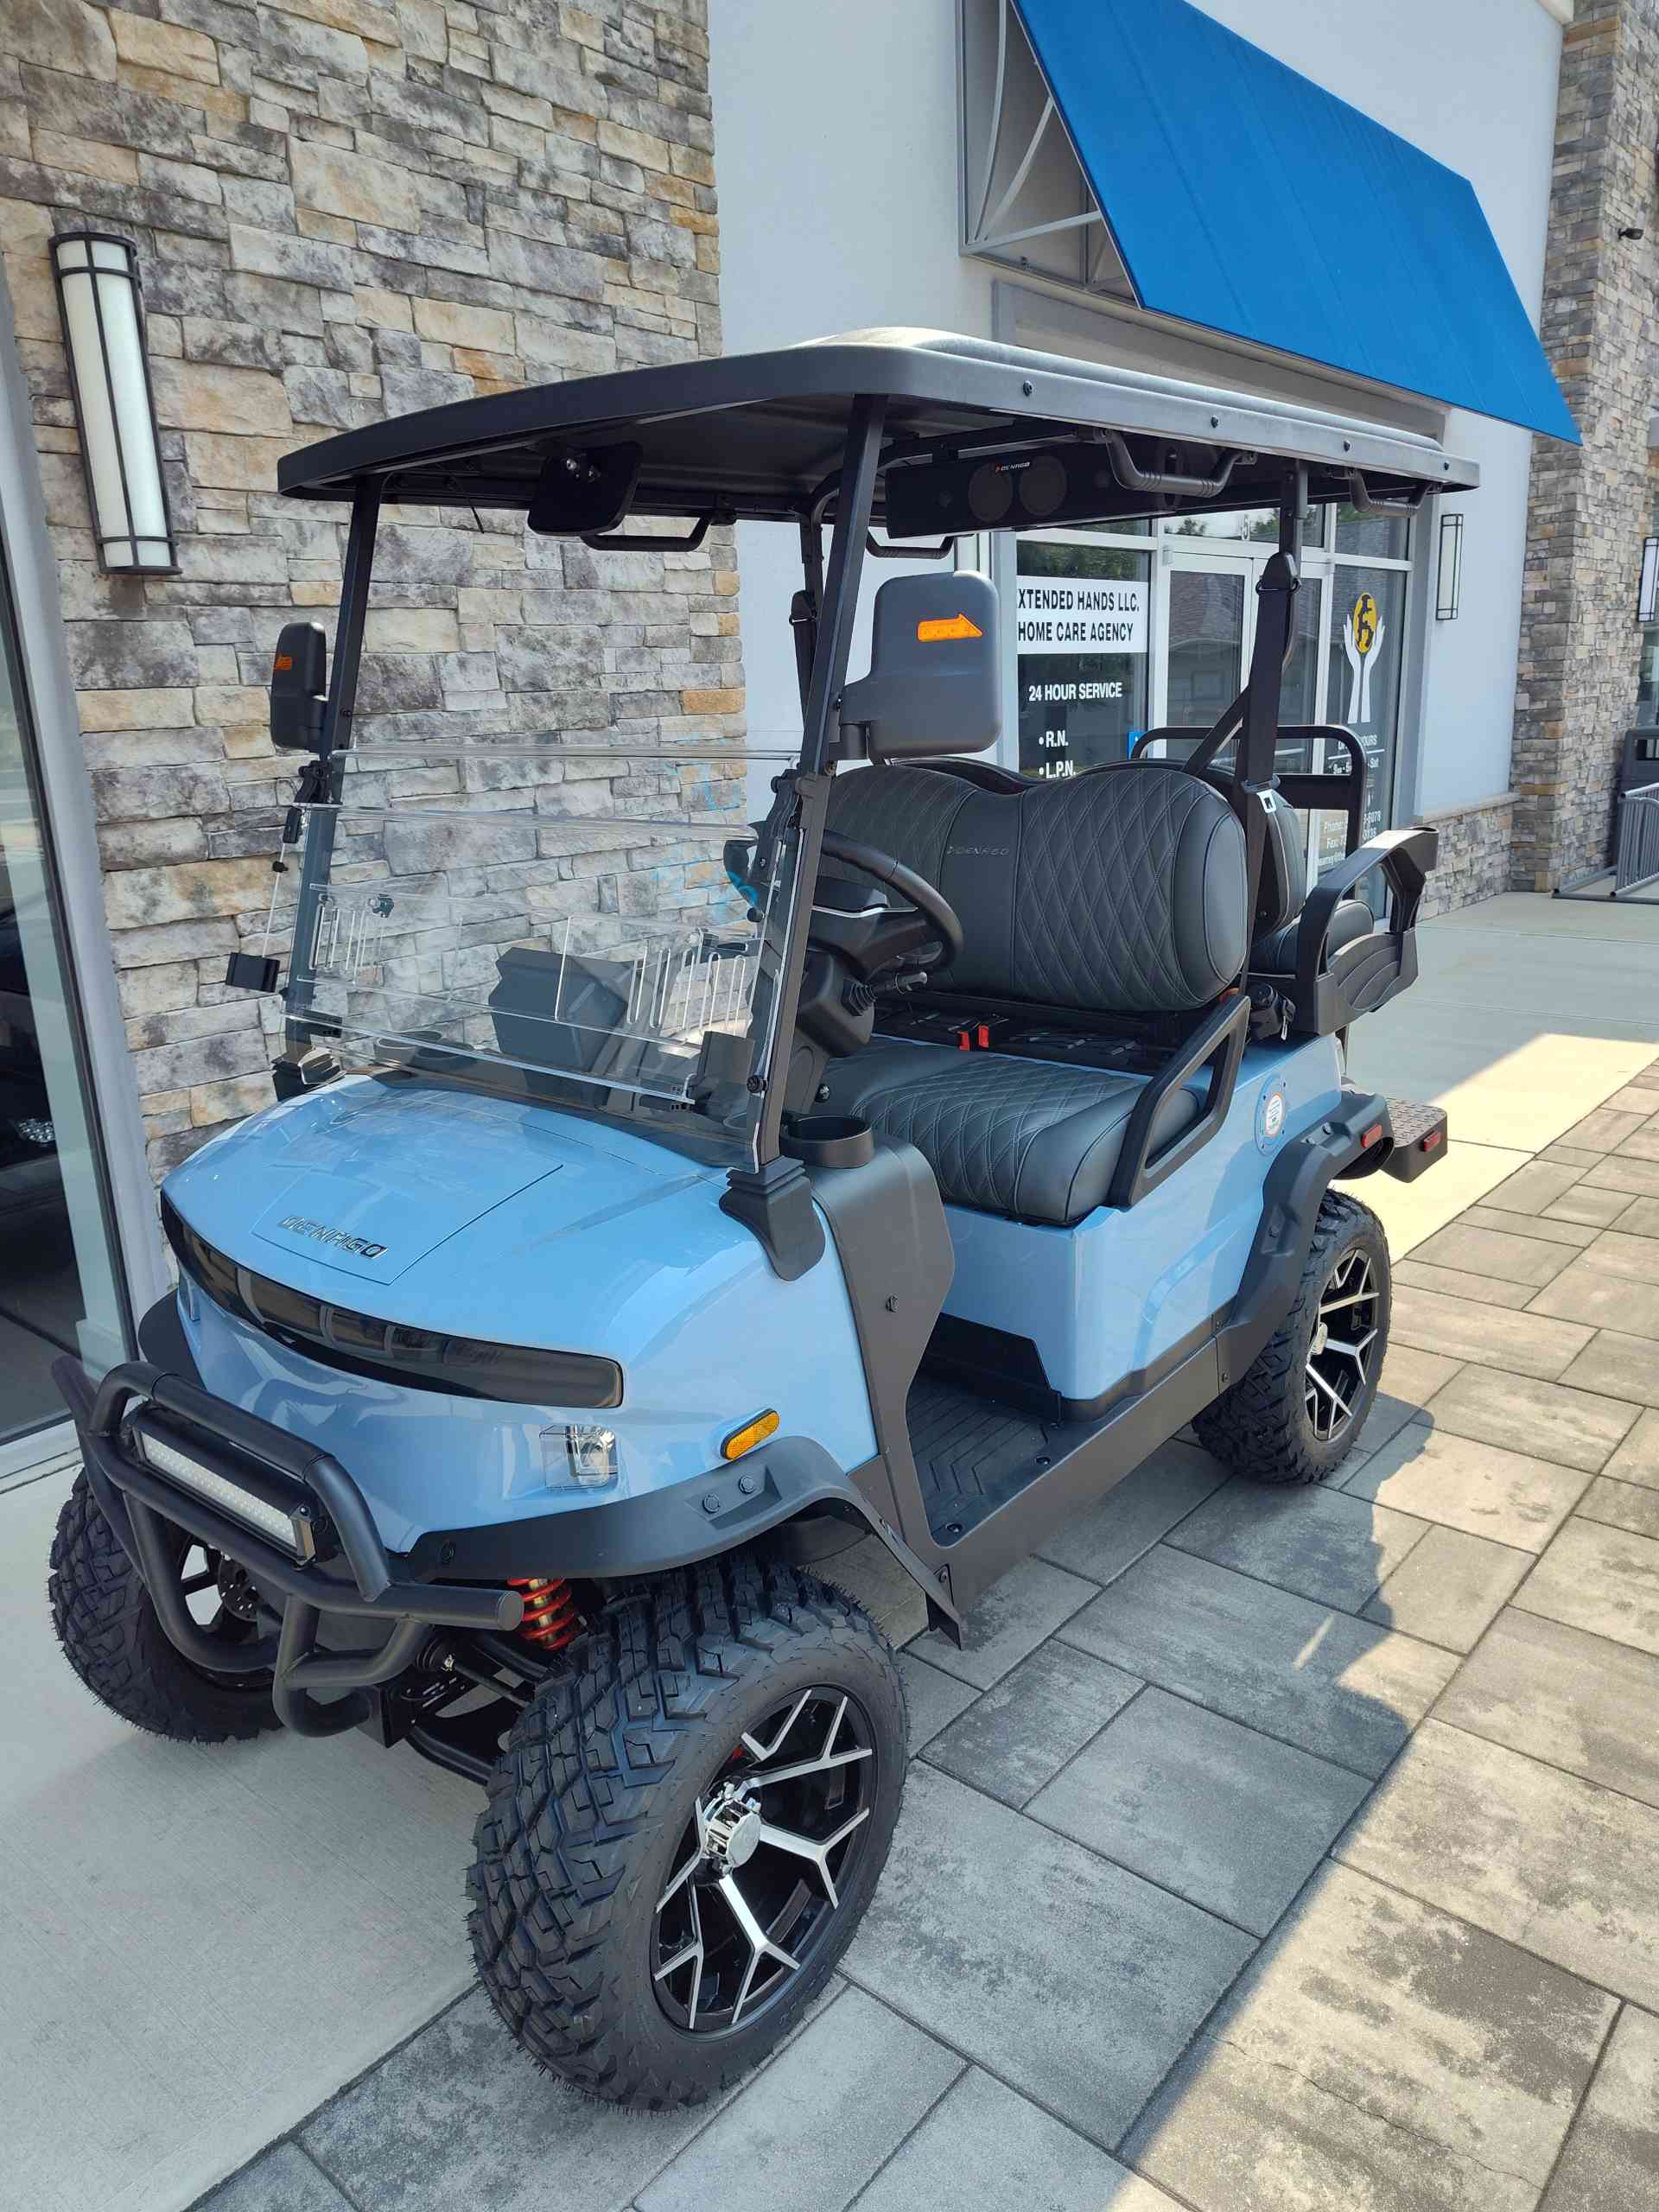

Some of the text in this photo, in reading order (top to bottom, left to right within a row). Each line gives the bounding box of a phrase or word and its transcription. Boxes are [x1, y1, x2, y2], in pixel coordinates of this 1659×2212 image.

[1077, 591, 1115, 611] HANDS
[1117, 592, 1140, 612] LLC.
[1018, 621, 1134, 641] HOME CARE AGENCY
[1028, 682, 1122, 702] 24 HOUR SERVICE
[276, 1216, 388, 1259] DENAGO
